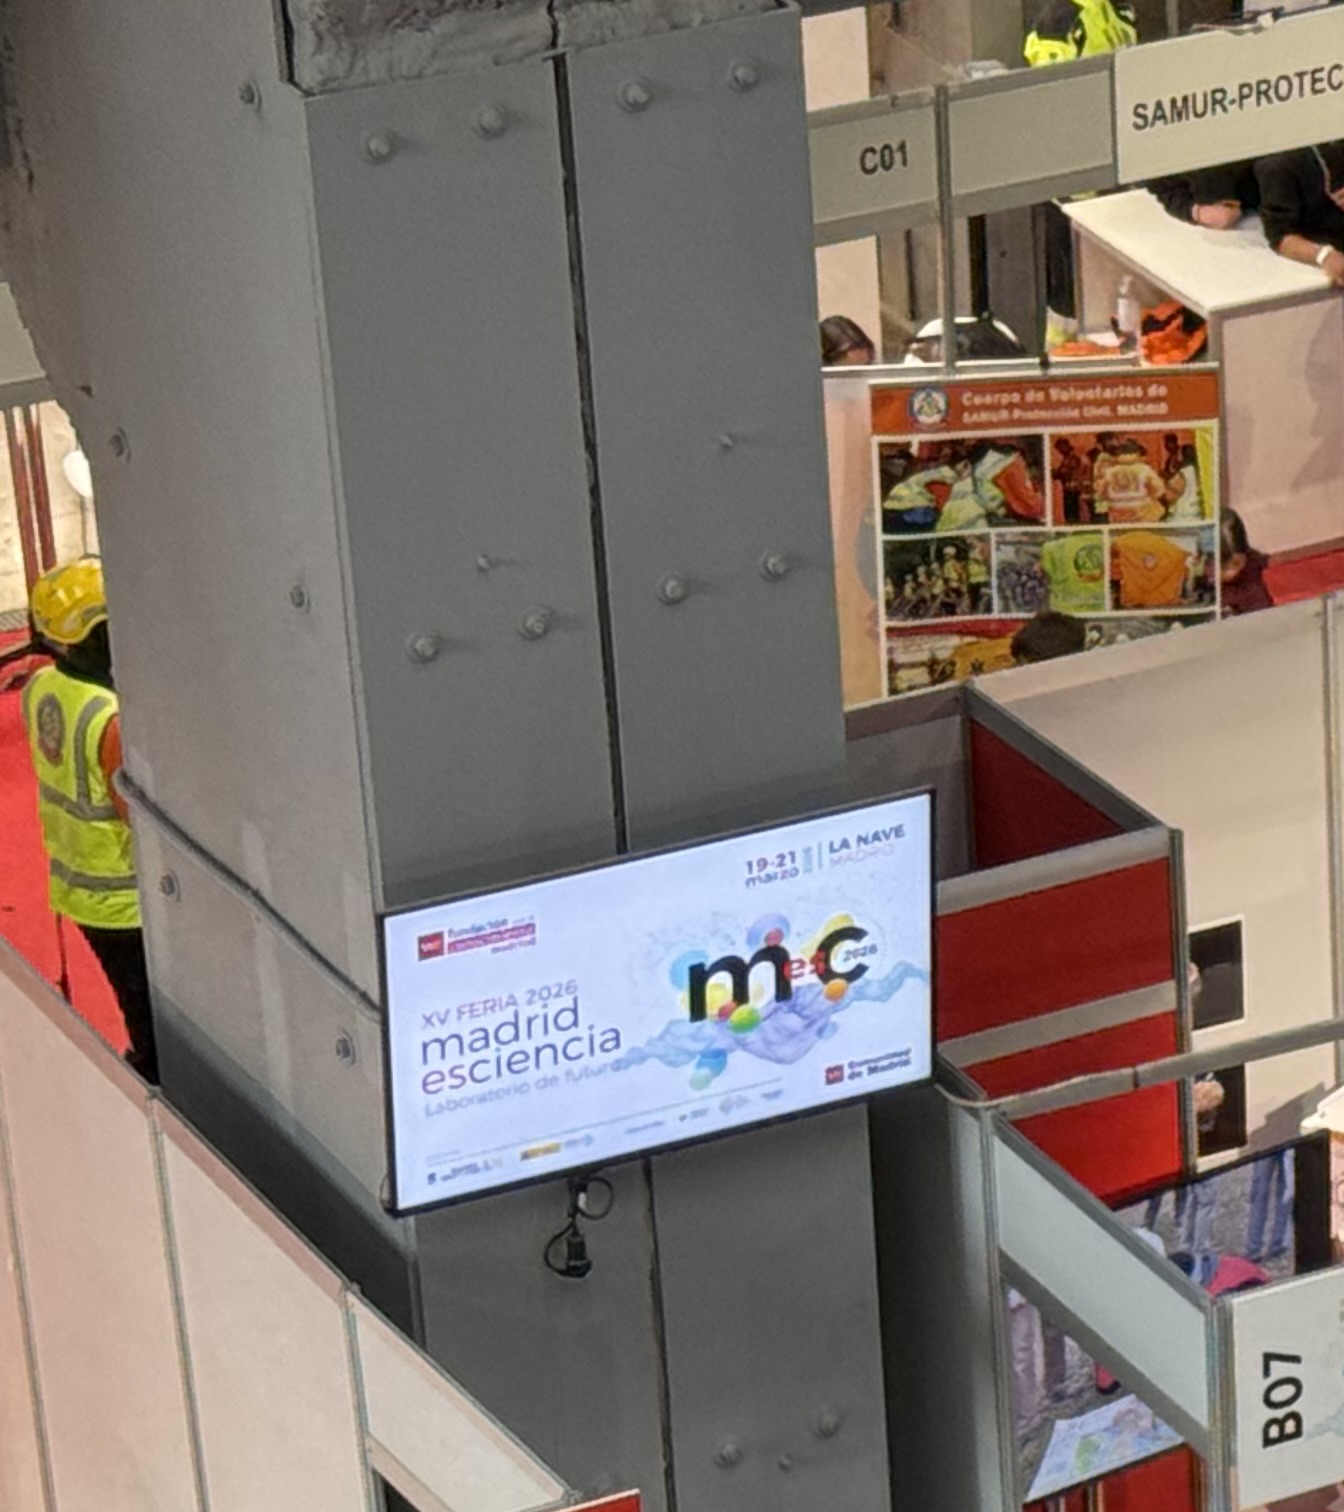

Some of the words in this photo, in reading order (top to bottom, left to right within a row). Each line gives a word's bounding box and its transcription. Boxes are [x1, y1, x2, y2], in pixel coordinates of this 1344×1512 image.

[859, 139, 910, 176] C01
[828, 837, 852, 853] LA
[855, 823, 906, 847] NAVE
[745, 850, 798, 876] 19-21
[745, 866, 800, 889] marzo
[422, 1008, 450, 1030] XV
[456, 993, 519, 1022] FERIA
[525, 979, 578, 1006] 2026
[422, 995, 580, 1066] madrid
[421, 1024, 622, 1096] esciencia
[424, 1079, 531, 1118] Laboratorio
[534, 1072, 561, 1090] de
[1261, 1350, 1303, 1449] B07
